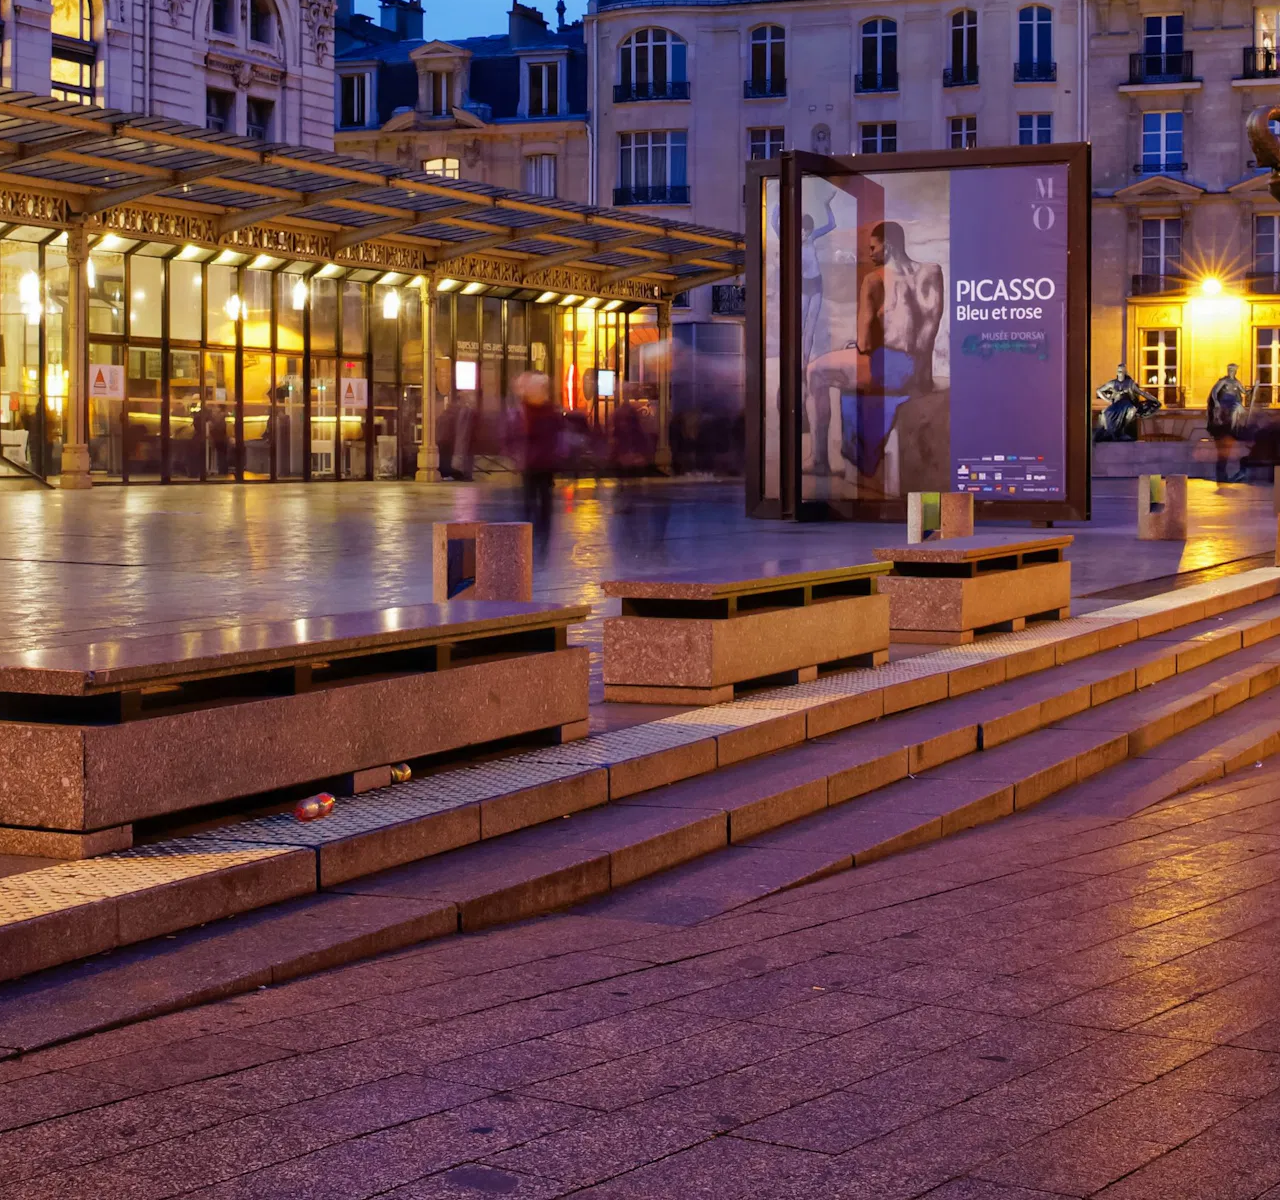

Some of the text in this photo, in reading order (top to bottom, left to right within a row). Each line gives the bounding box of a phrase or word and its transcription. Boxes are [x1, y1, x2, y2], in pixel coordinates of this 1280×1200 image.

[956, 277, 1055, 302] PICASSO
[956, 304, 1042, 321] Bleu et rose
